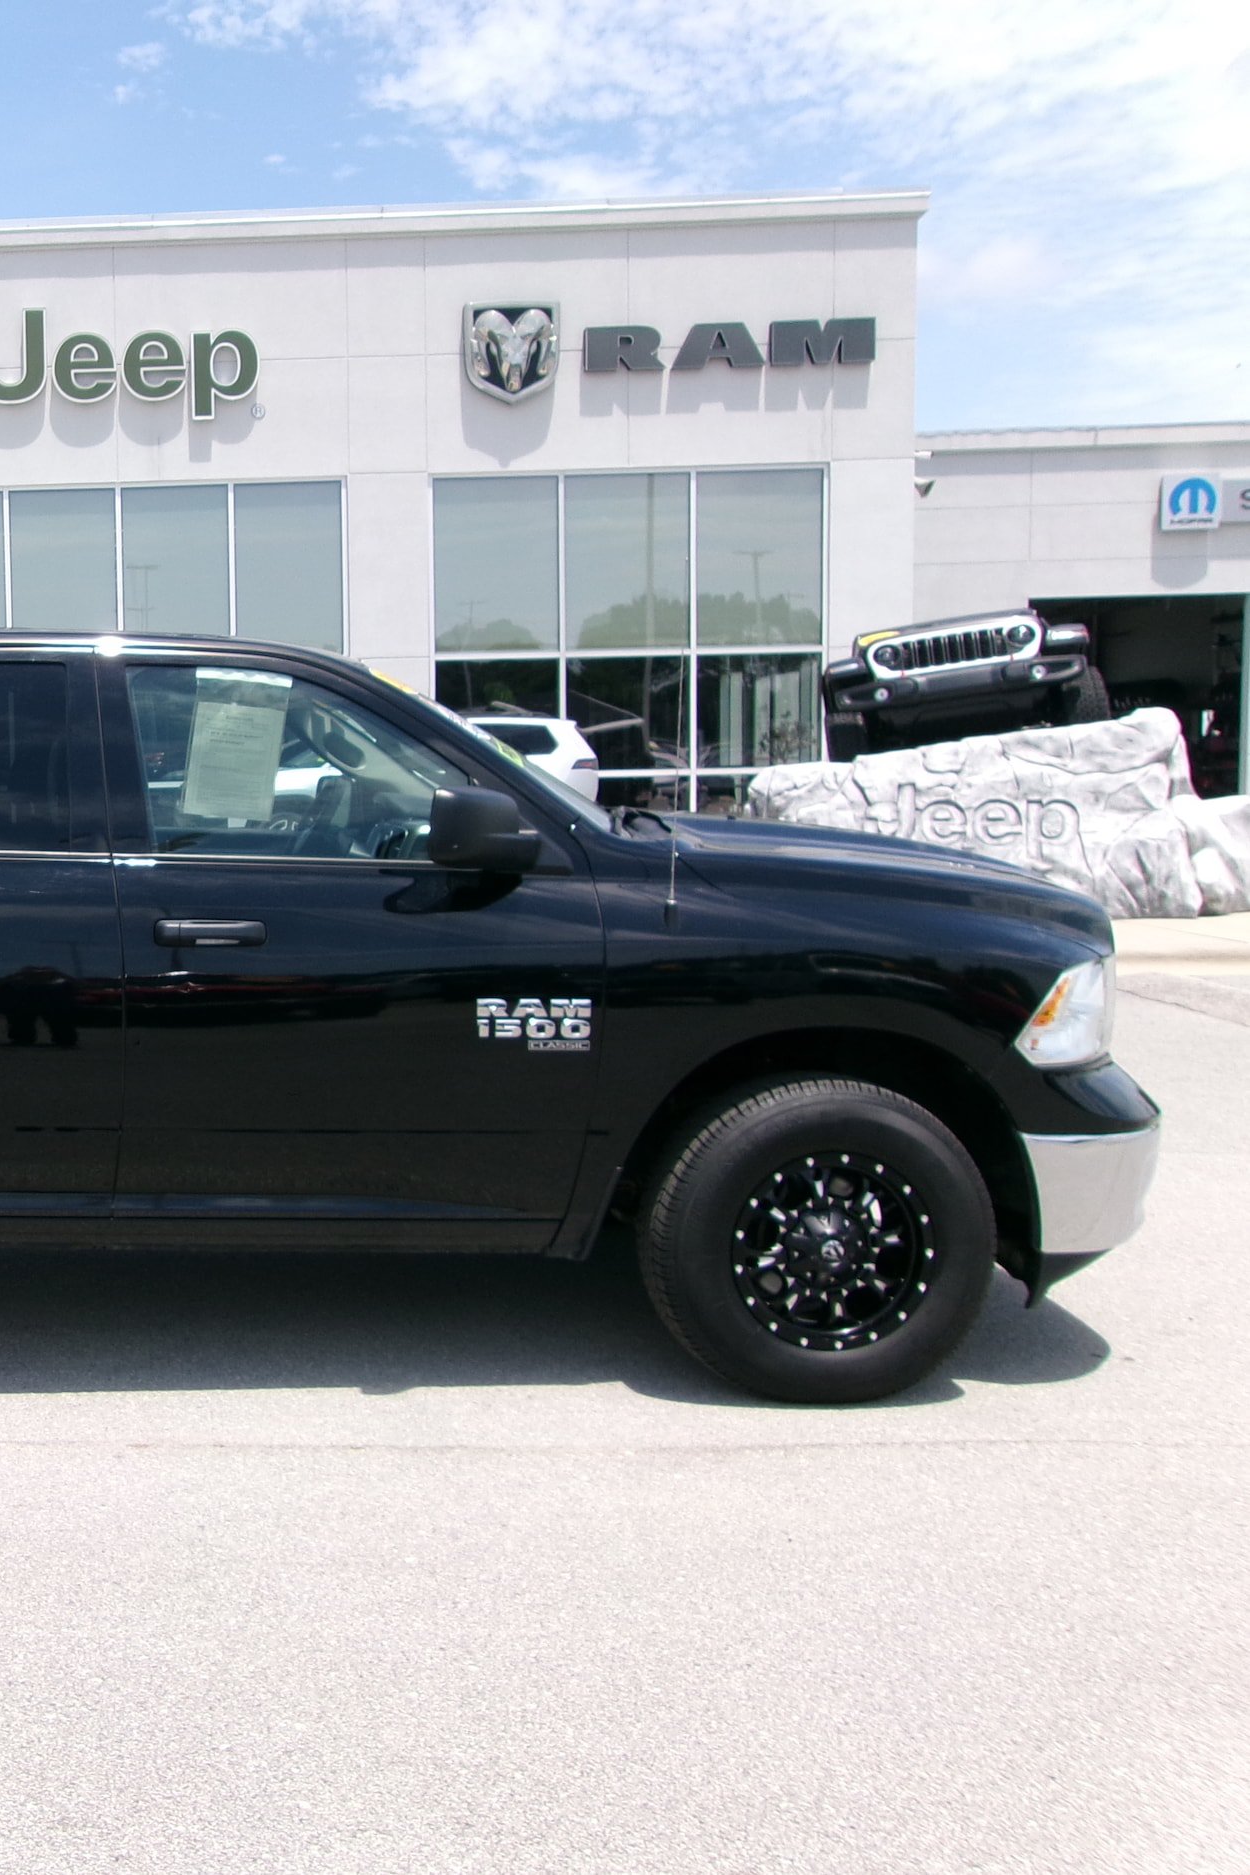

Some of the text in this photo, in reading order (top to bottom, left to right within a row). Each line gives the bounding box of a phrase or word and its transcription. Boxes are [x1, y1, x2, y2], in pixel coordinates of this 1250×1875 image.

[583, 316, 877, 372] RAM
[863, 783, 1080, 870] Jeep
[476, 998, 592, 1017] RAM
[476, 1018, 591, 1039] 1500
[530, 1040, 589, 1050] CLASSIC
